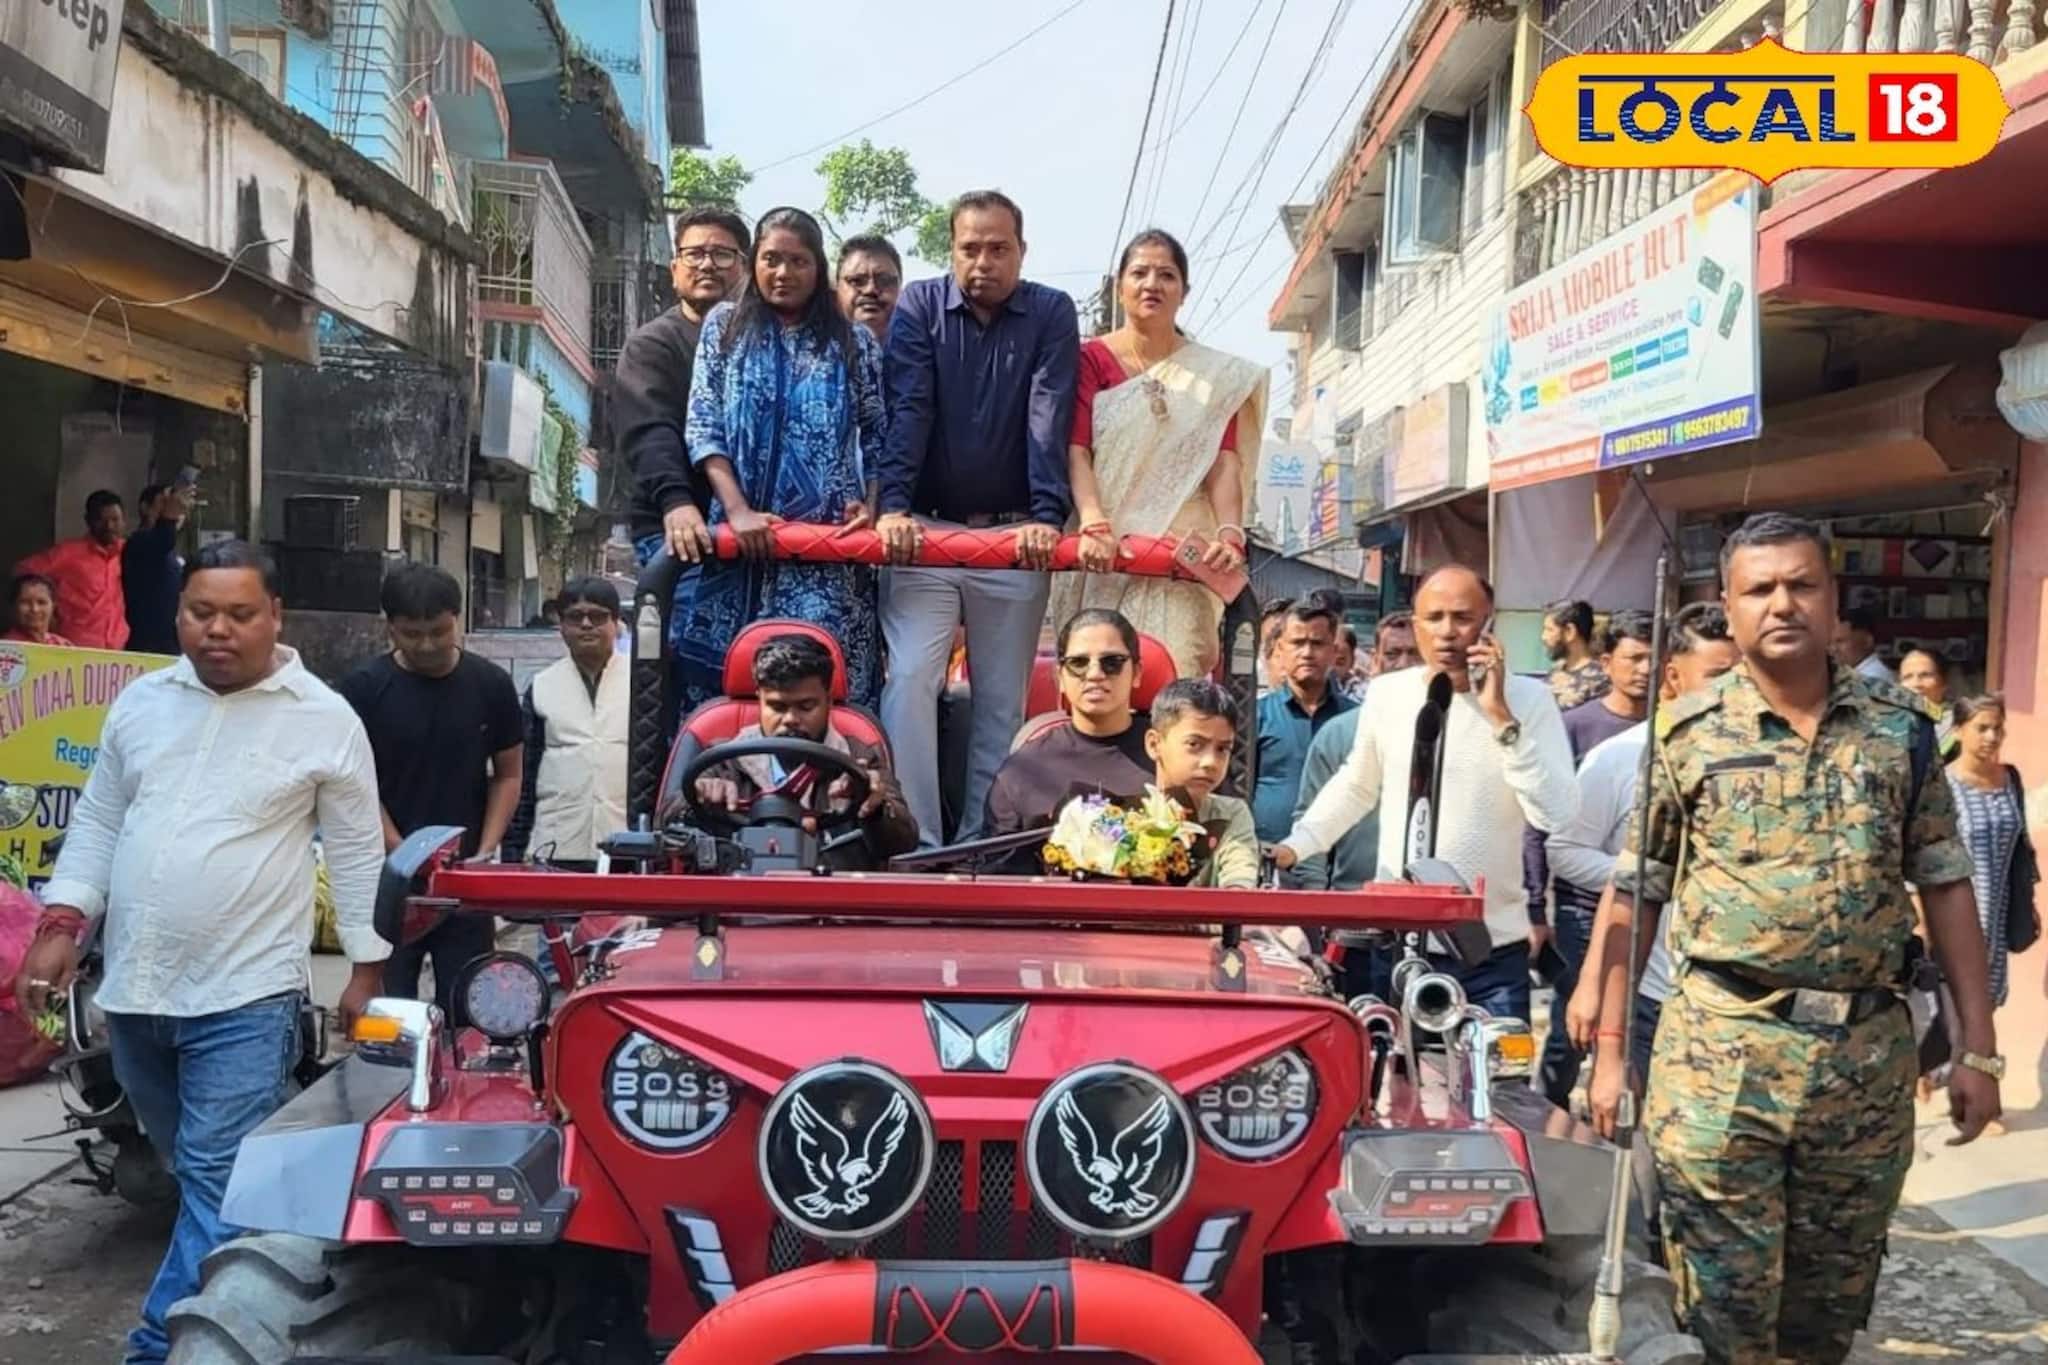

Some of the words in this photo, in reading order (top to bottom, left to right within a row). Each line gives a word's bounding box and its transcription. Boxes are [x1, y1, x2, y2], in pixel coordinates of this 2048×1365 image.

[1562, 242, 1637, 316] MOBILE
[1546, 325, 1573, 353] SALE
[1587, 298, 1640, 337] SERVICE
[33, 666, 76, 720] MAA
[83, 663, 144, 705] DURG
[613, 1072, 729, 1098] BOSS
[1198, 1083, 1306, 1110] BOSS
